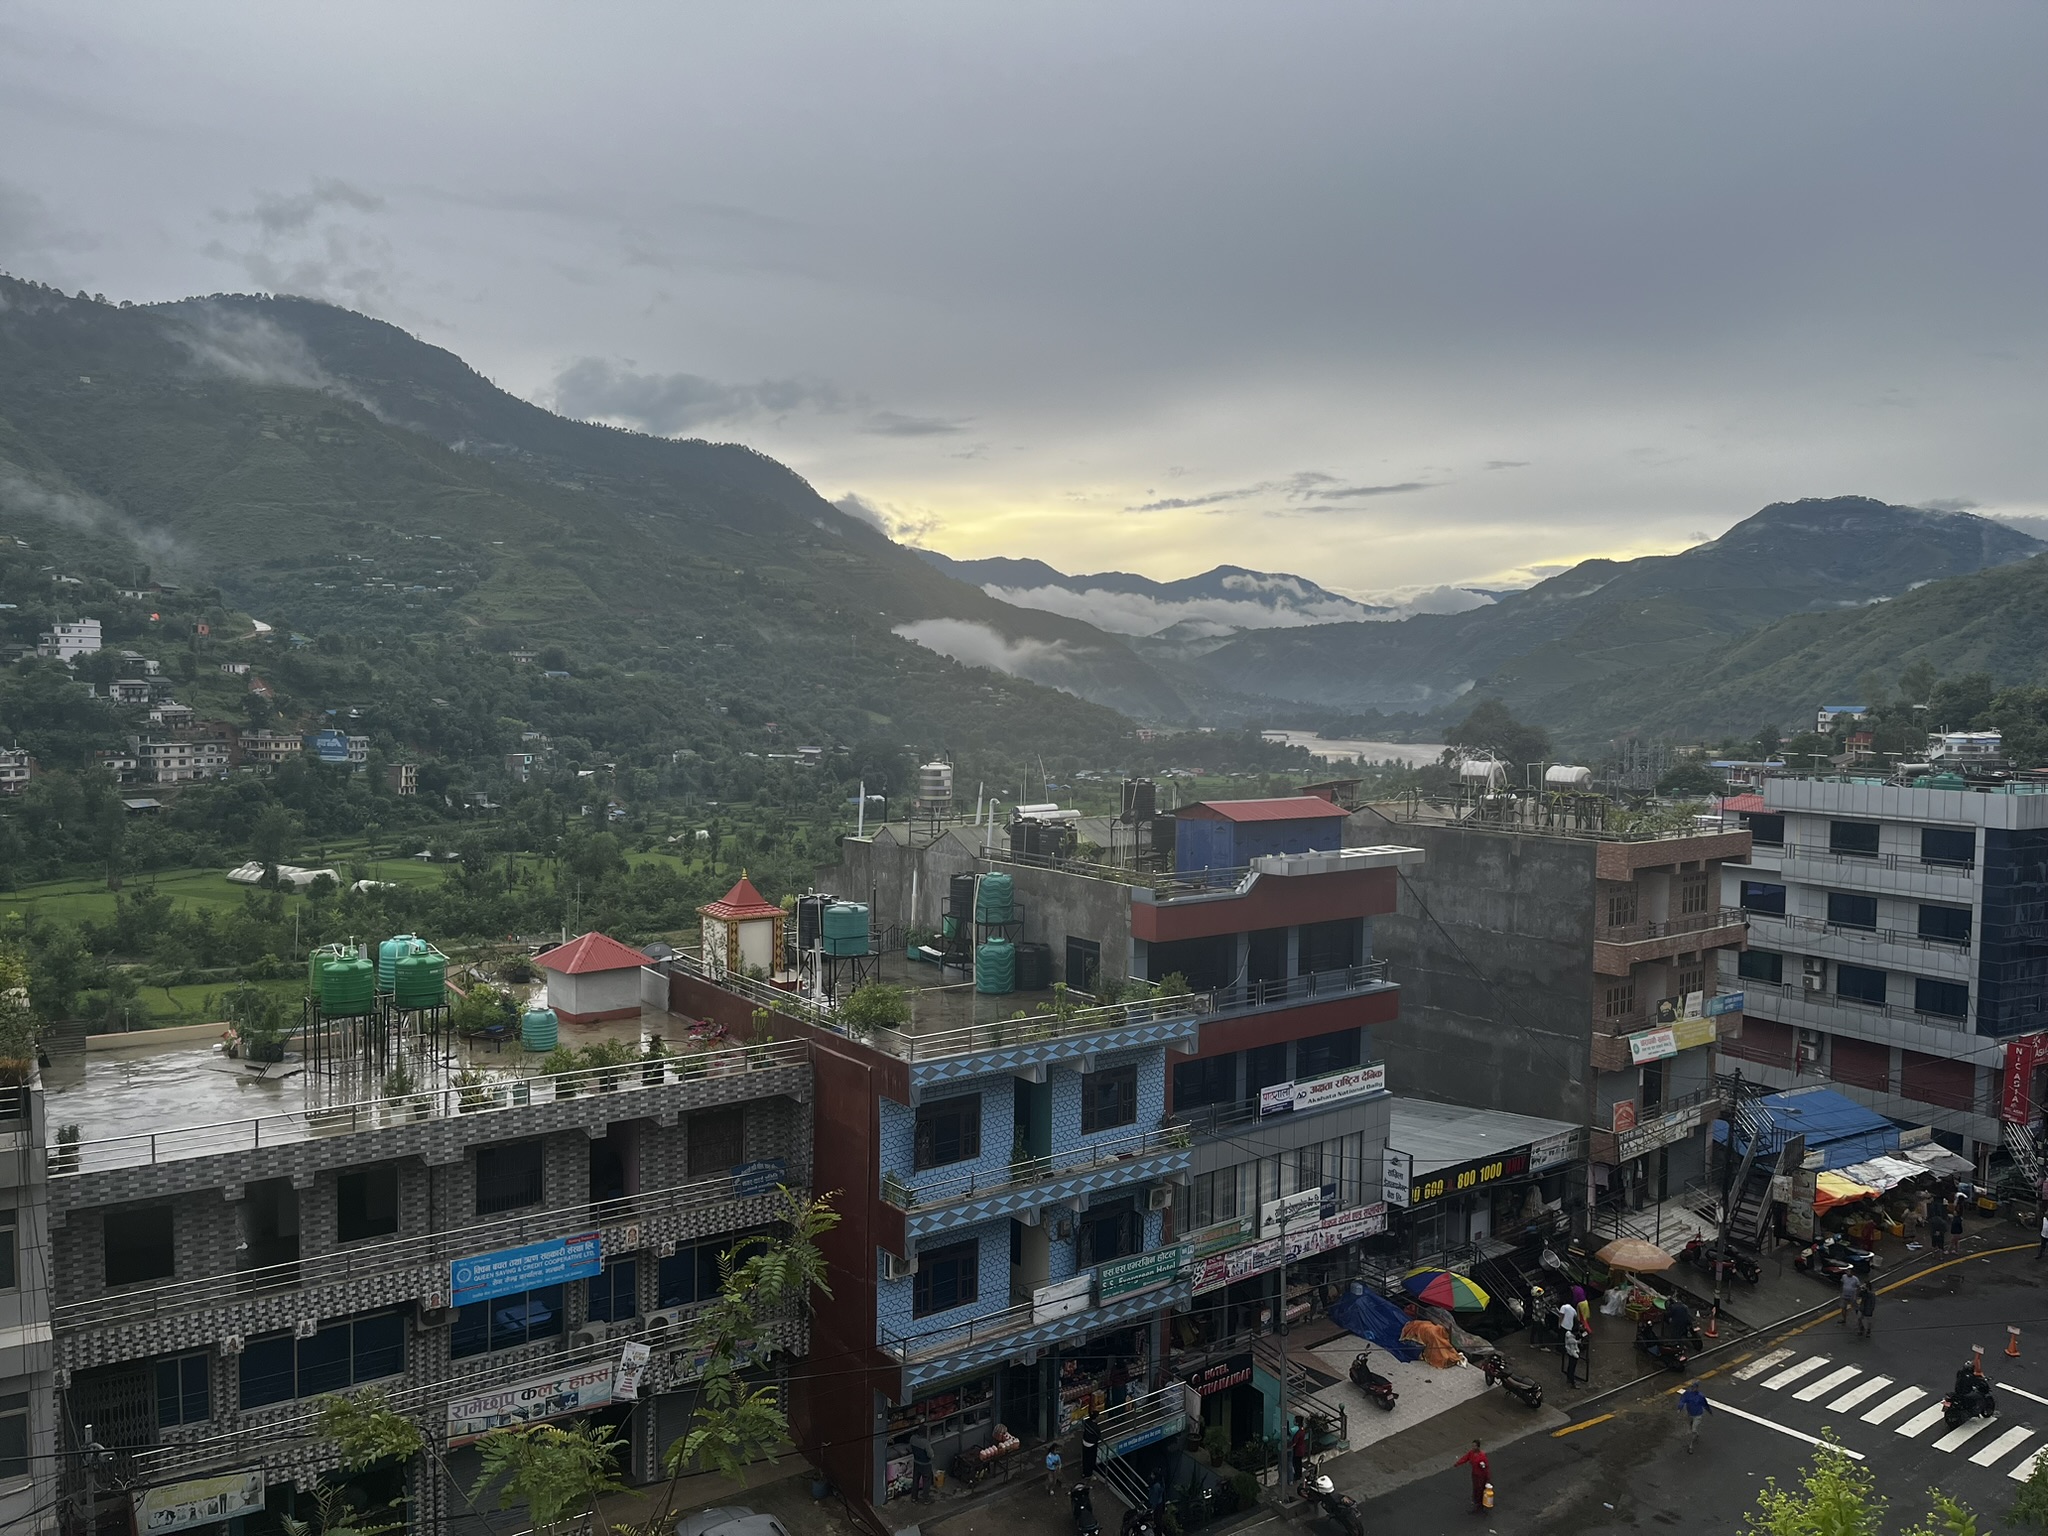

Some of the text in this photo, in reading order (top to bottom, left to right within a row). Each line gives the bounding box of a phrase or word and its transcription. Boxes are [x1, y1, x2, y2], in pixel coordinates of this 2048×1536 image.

[1310, 1082, 1333, 1094] अक्षता
[1362, 1069, 1382, 1081] दैनिक
[2012, 1047, 2023, 1103] NIC ASIA
[1308, 1082, 1382, 1103] Akshata National Daily
[1424, 1180, 1444, 1200] 600
[1457, 1170, 1476, 1189] 800
[1480, 1162, 1503, 1182] 1000
[540, 1247, 565, 1260] सहकारी
[567, 1244, 583, 1254] संस्था
[1158, 1249, 1175, 1261] होटल
[474, 1273, 494, 1282] QUEEN
[495, 1268, 517, 1277] SAVING
[523, 1262, 543, 1270] CREDIT
[544, 1253, 583, 1266] COOPERATIVE
[1119, 1271, 1154, 1286] Evergreen
[1157, 1262, 1175, 1273] Hotel
[1204, 1364, 1229, 1381] HOTEL
[453, 1368, 609, 1419] रामेछाप कलर हाउस
